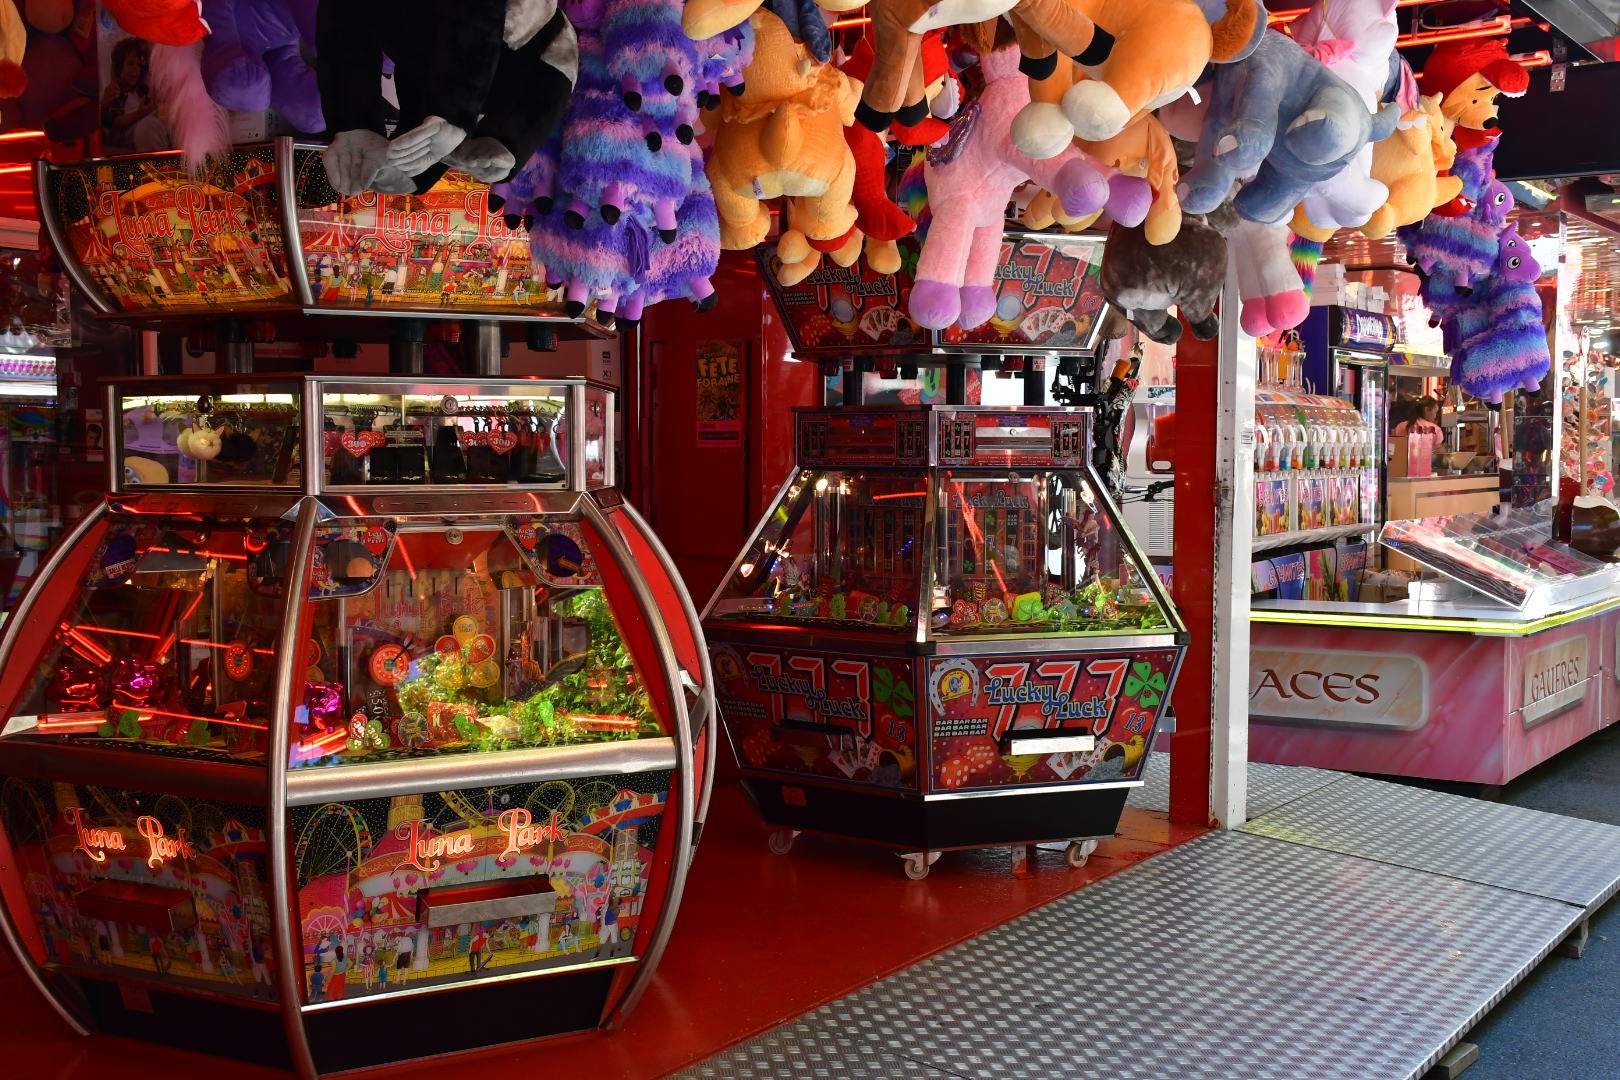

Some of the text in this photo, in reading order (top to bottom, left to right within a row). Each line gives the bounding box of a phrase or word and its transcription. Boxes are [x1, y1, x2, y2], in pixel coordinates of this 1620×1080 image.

[99, 184, 247, 258] Luna Park
[356, 189, 528, 256] Luna Par
[993, 261, 1075, 297] ucky Luck
[696, 373, 741, 388] FORAINE
[697, 356, 738, 378] FÊTE
[750, 663, 867, 720] Lucky Luck
[983, 657, 1132, 743] 777
[984, 676, 1054, 714] Lucky
[1053, 691, 1108, 719] Luck
[1249, 668, 1380, 704] ACES
[888, 719, 908, 743] 13
[1123, 712, 1146, 733] 13
[64, 806, 196, 869] Luna Park
[391, 807, 569, 873] Luna Park
